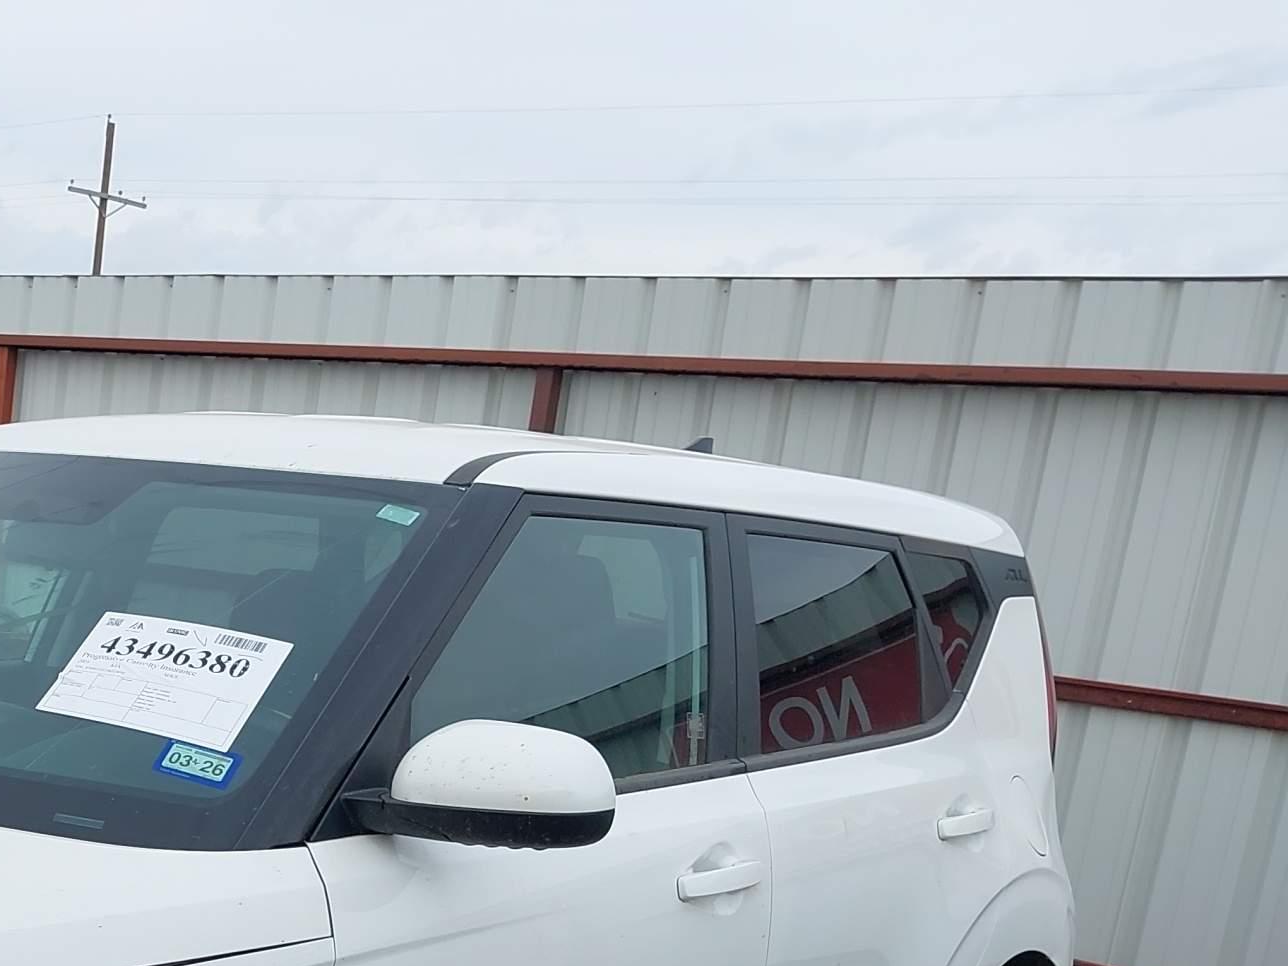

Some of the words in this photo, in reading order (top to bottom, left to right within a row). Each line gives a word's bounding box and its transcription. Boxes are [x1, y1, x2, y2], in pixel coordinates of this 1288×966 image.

[100, 636, 250, 678] 43496380
[169, 752, 193, 767] 03
[199, 760, 226, 777] 26
